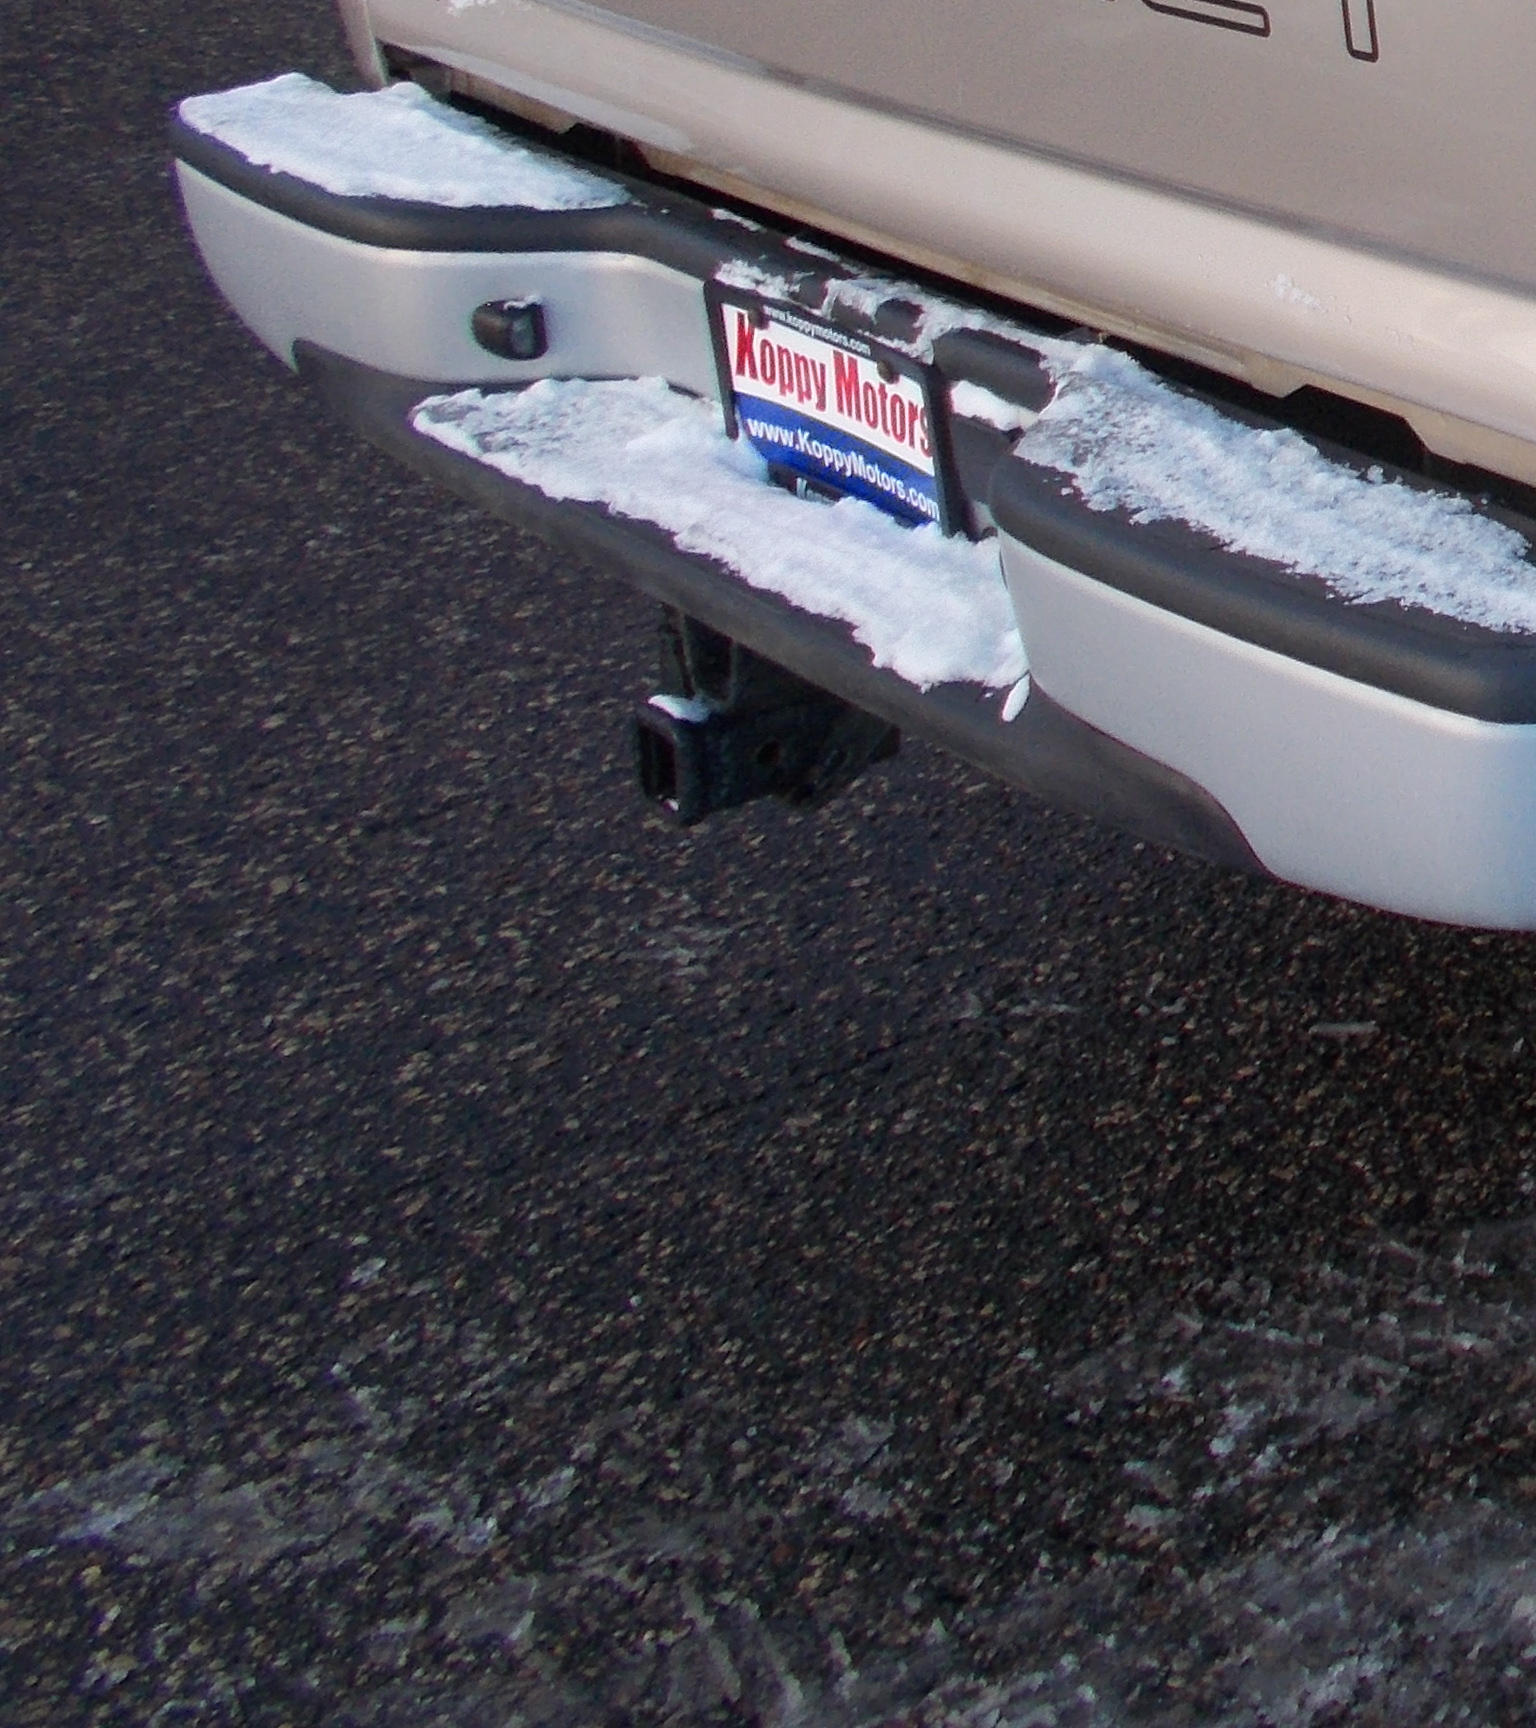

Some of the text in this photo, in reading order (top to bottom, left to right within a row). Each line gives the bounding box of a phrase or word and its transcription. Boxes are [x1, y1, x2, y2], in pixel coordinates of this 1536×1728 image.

[735, 310, 933, 459] Koppy Motors
[746, 417, 940, 523] www.KoppyMotors.com
